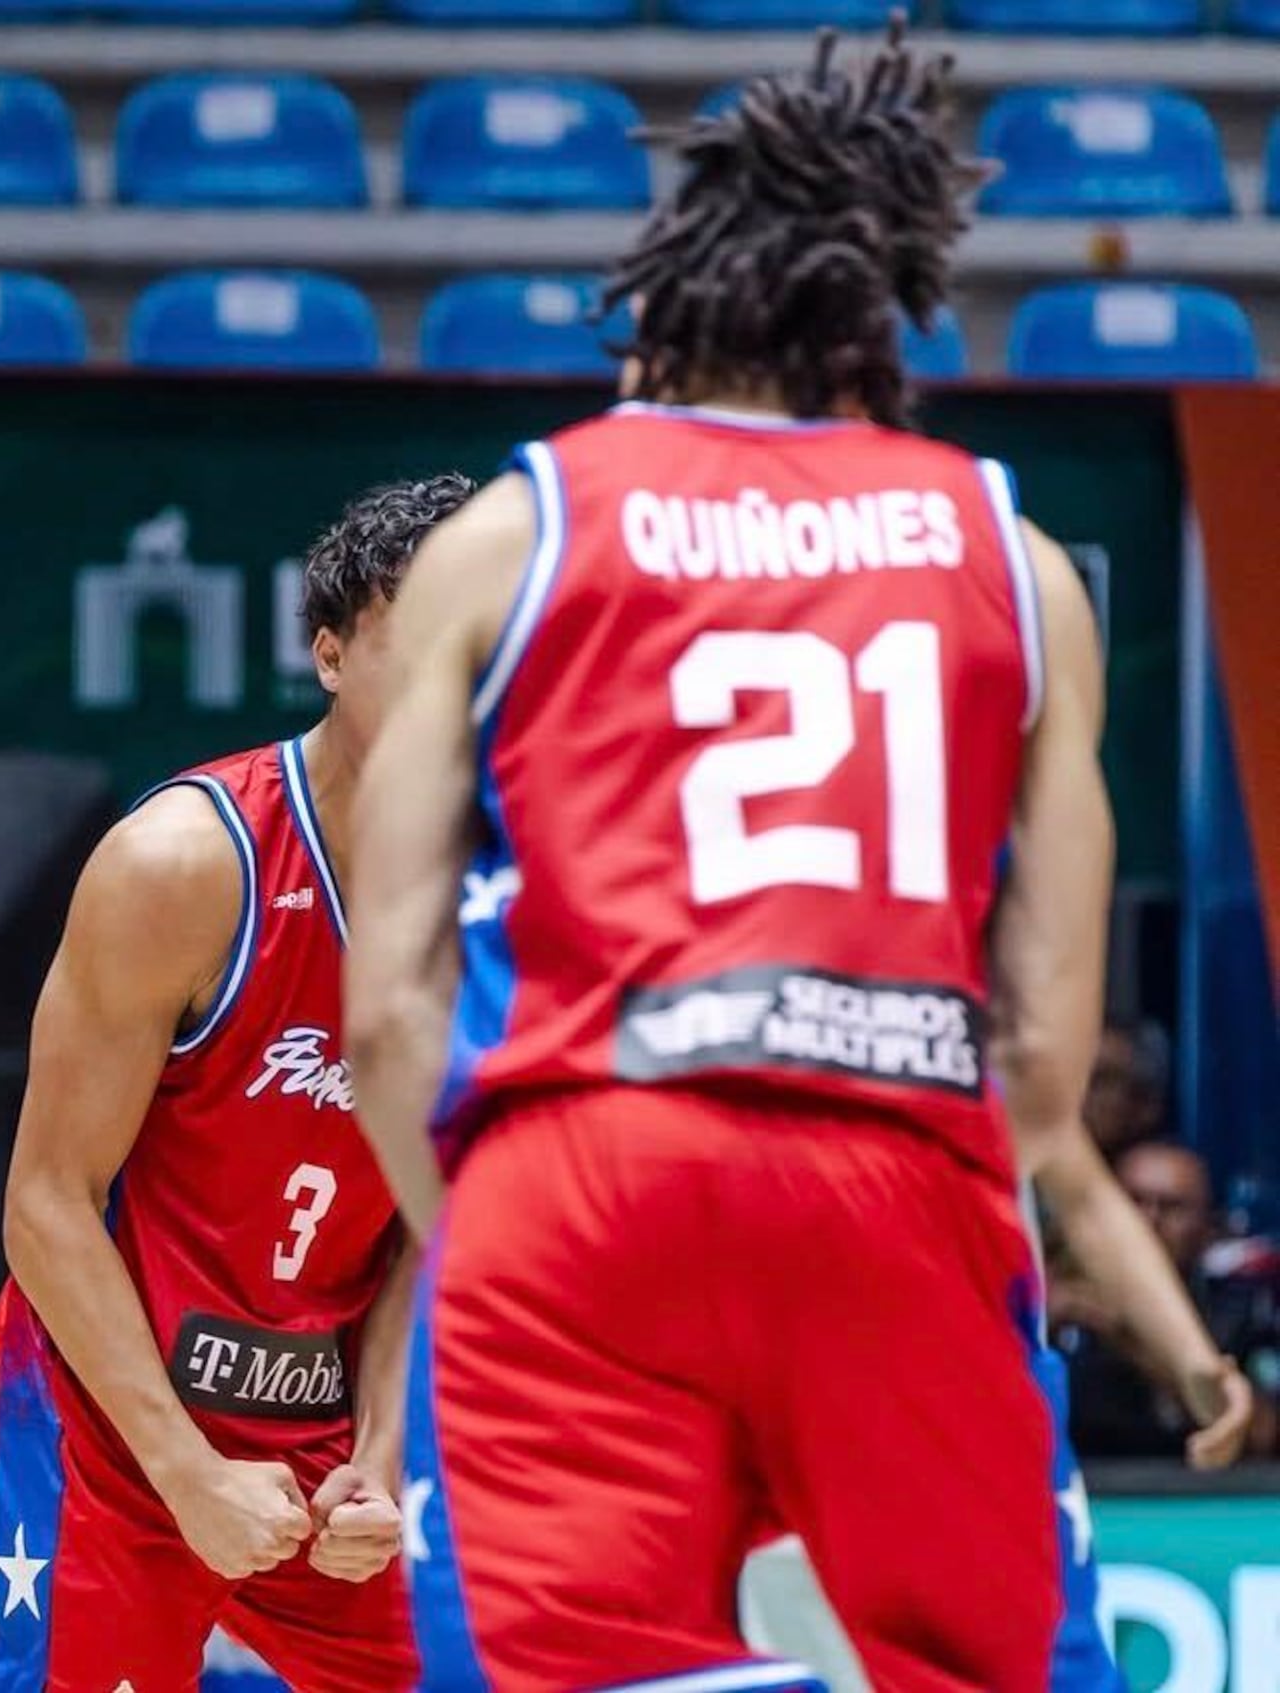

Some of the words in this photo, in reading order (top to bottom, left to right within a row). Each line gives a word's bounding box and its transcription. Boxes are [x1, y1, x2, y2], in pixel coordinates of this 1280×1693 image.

[622, 488, 964, 581] QUIÑONES
[670, 620, 950, 905] 21
[273, 1162, 338, 1282] 3
